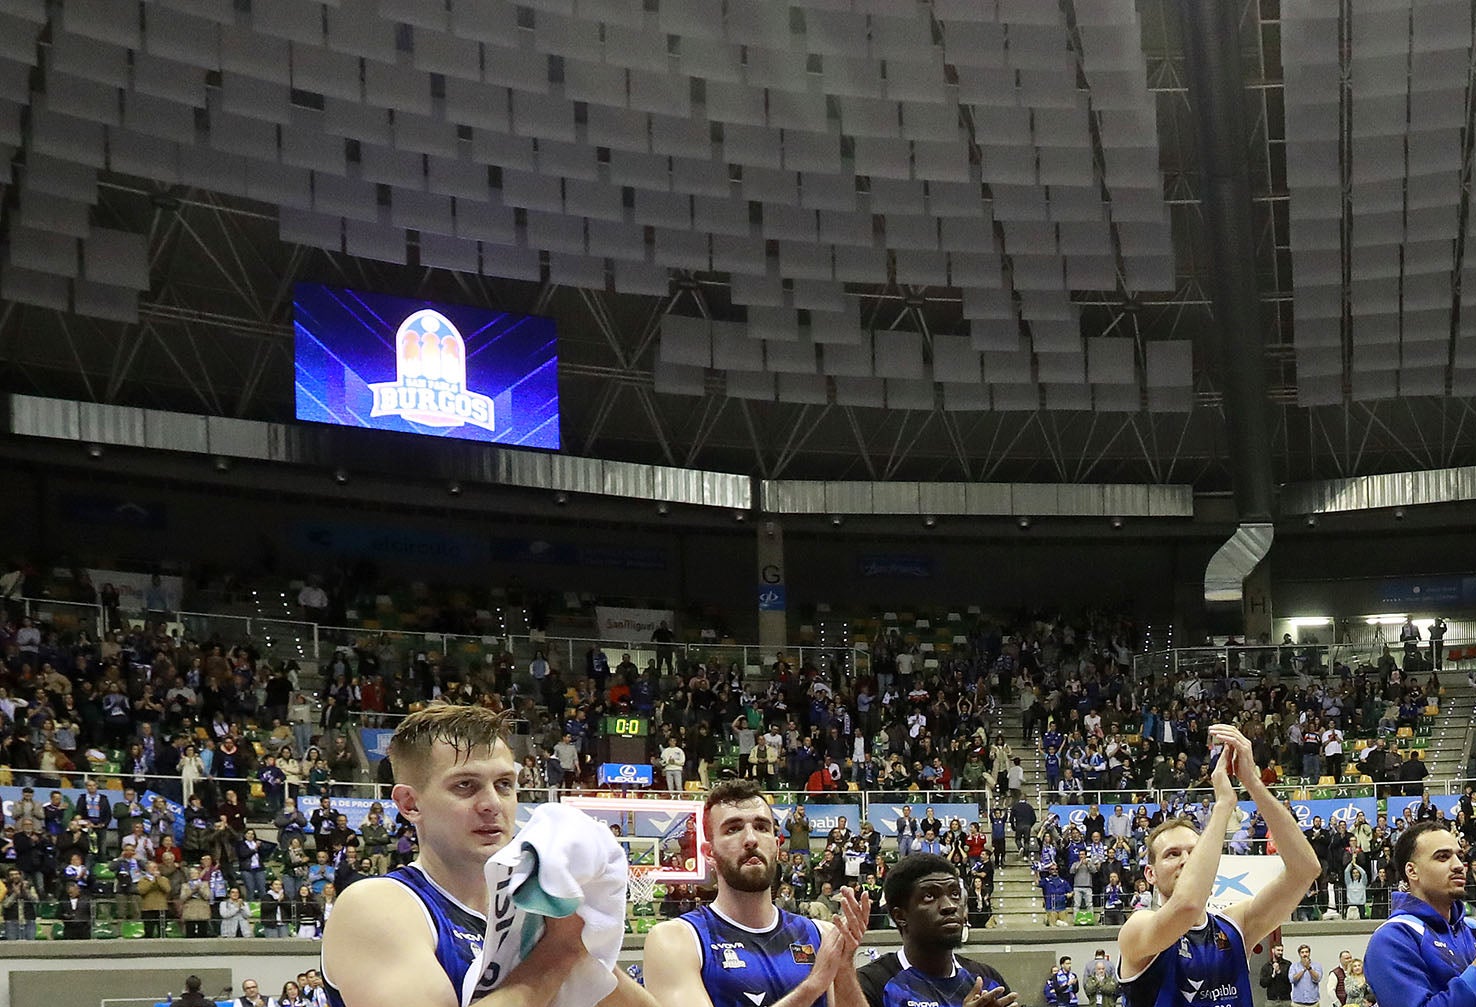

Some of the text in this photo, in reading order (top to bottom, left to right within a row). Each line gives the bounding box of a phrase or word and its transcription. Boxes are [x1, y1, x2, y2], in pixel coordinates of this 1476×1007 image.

[380, 387, 488, 422] BURGOS
[761, 564, 781, 585] G
[607, 775, 649, 784] LEXUS
[907, 1000, 939, 1007] GIVOVA
